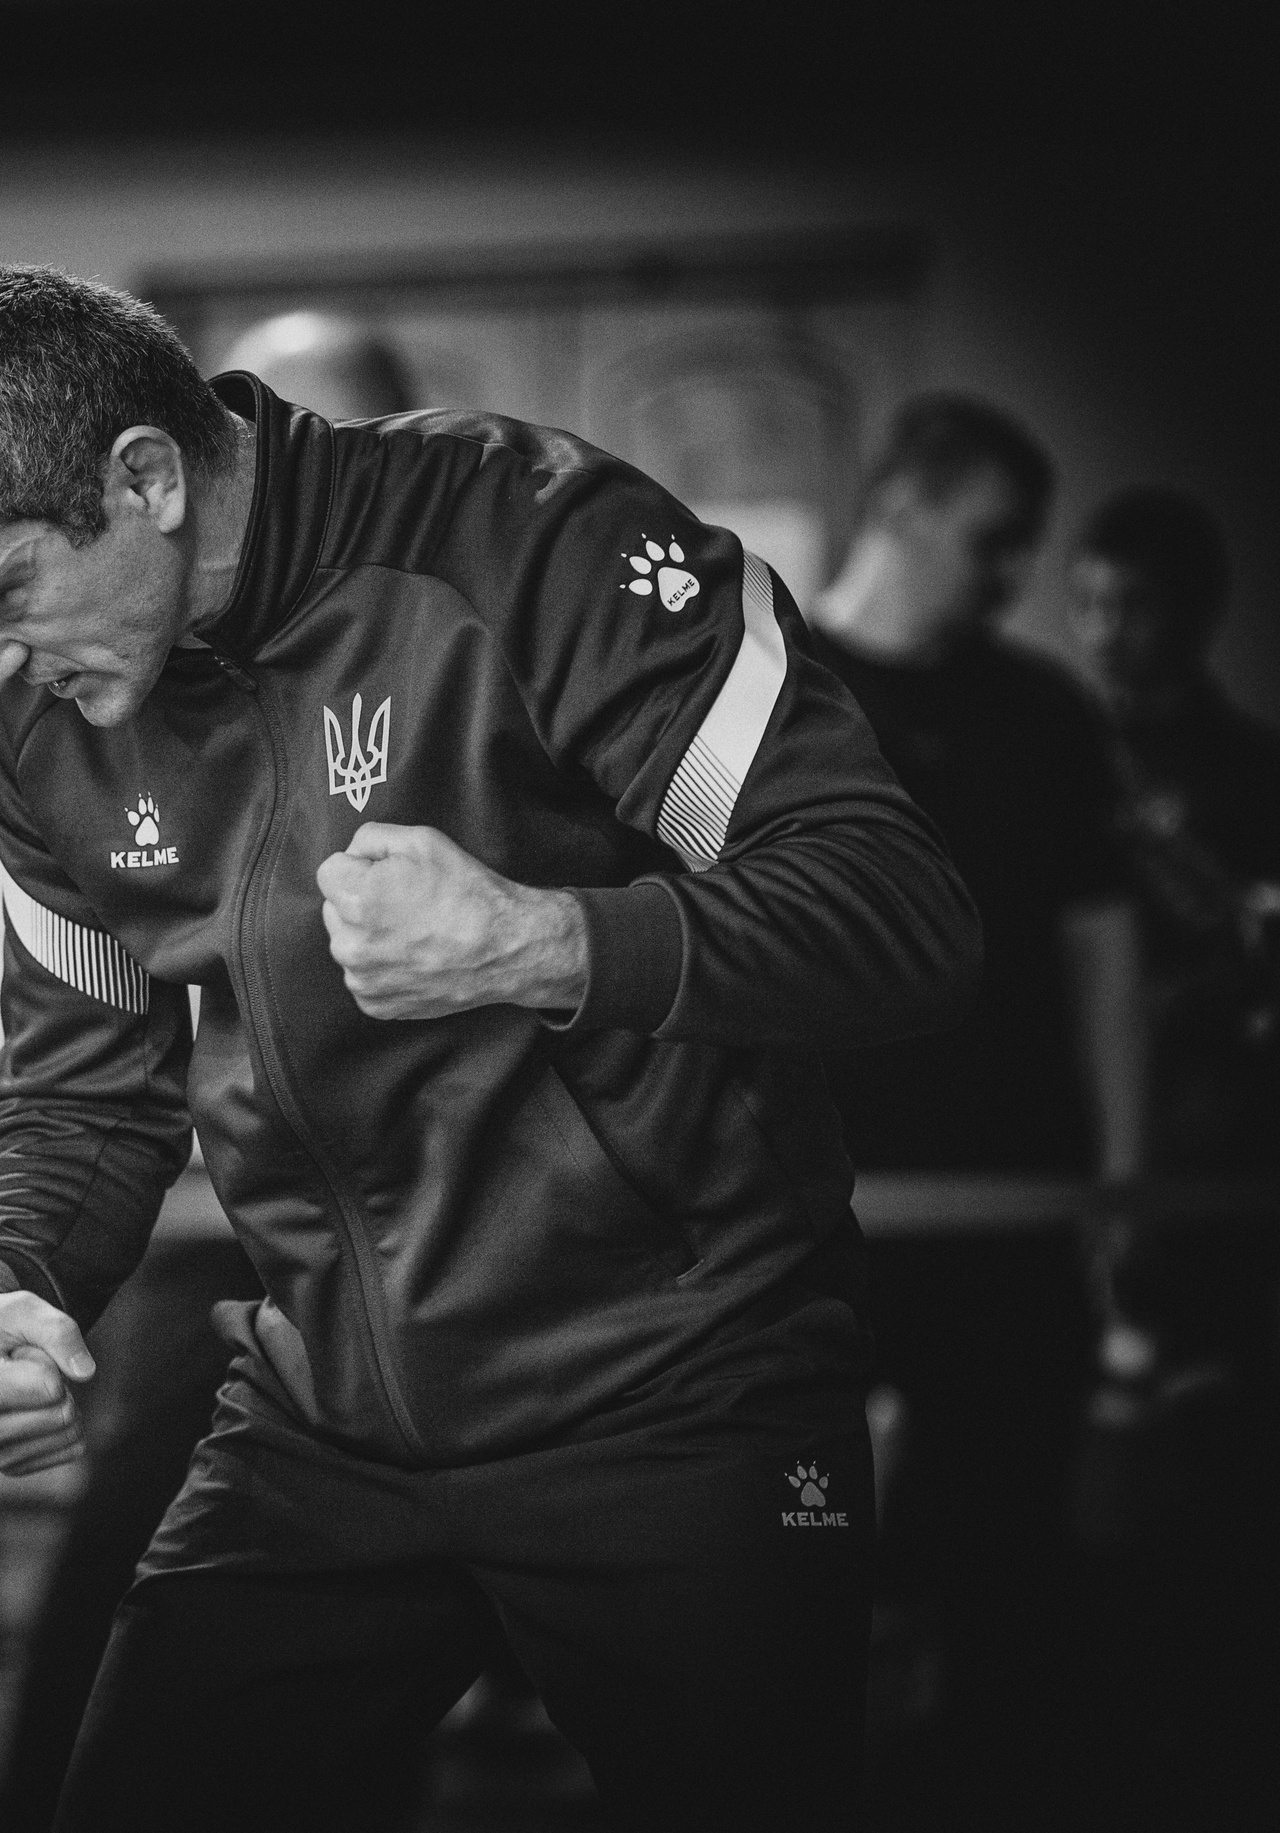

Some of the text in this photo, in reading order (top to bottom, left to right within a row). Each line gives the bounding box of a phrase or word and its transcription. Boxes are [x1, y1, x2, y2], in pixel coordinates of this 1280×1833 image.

[667, 578, 695, 606] KELME
[110, 846, 180, 869] KELME
[781, 1511, 849, 1527] KELME
